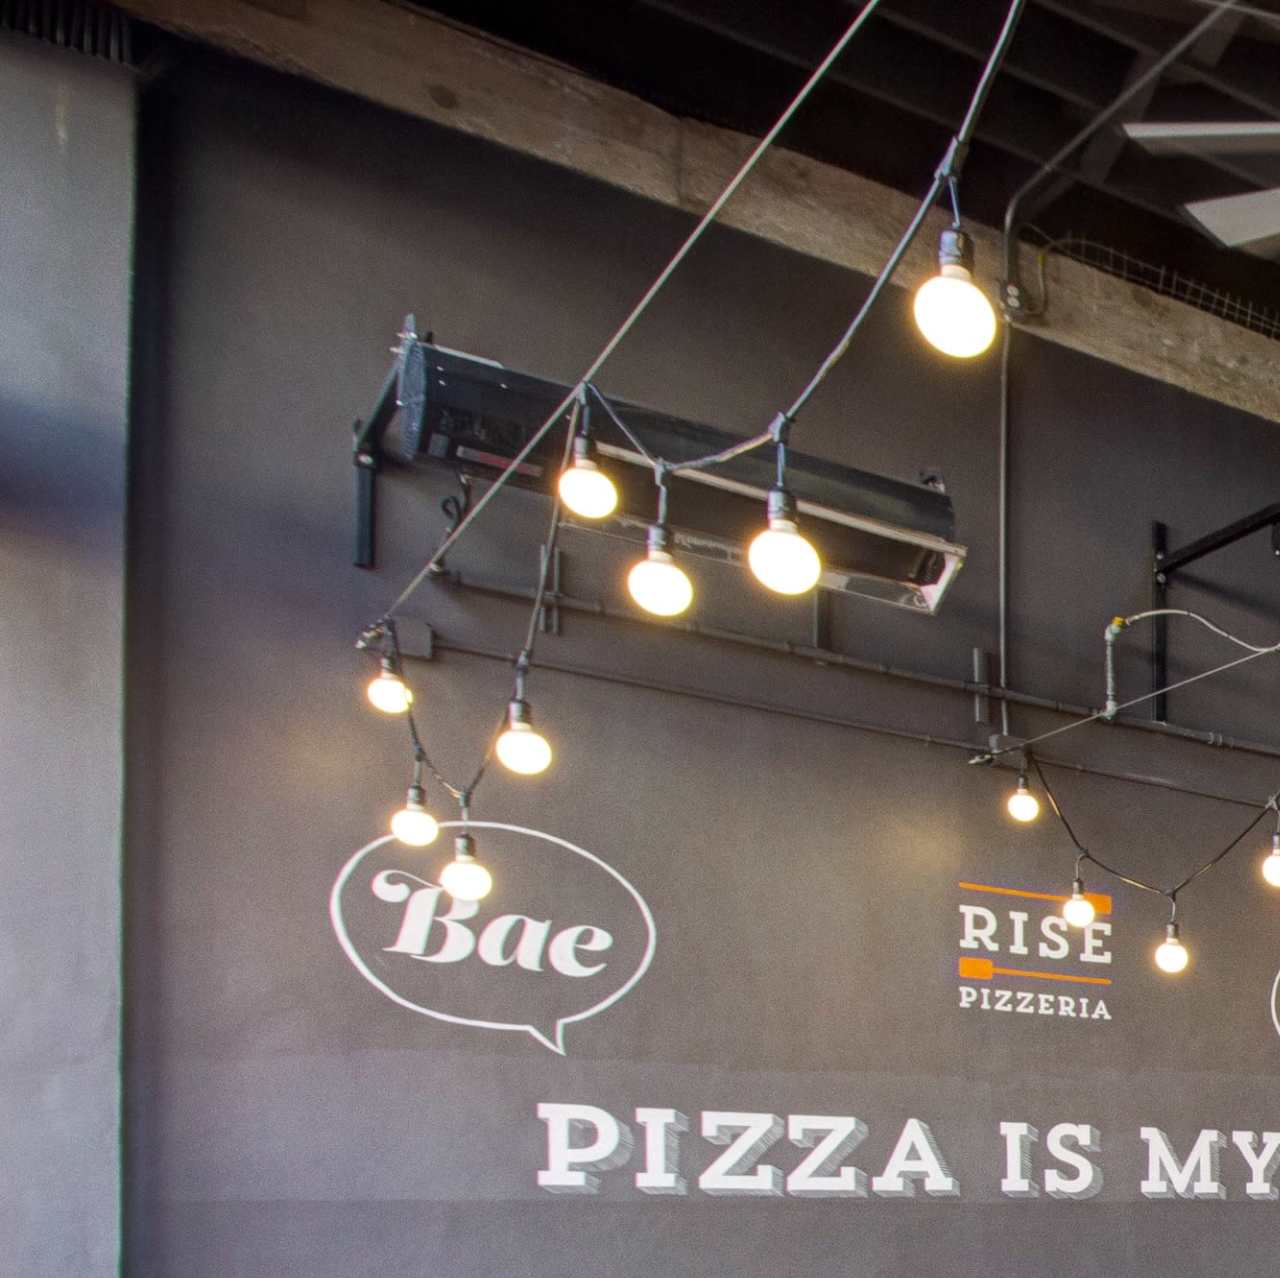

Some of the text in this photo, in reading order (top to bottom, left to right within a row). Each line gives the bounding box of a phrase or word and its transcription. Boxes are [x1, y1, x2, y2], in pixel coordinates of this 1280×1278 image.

[371, 869, 613, 977] Bae
[959, 904, 1112, 964] RISE
[959, 986, 1112, 1020] PIZZERIA
[537, 1102, 960, 1198] PIZZA
[1000, 1121, 1103, 1199] IS
